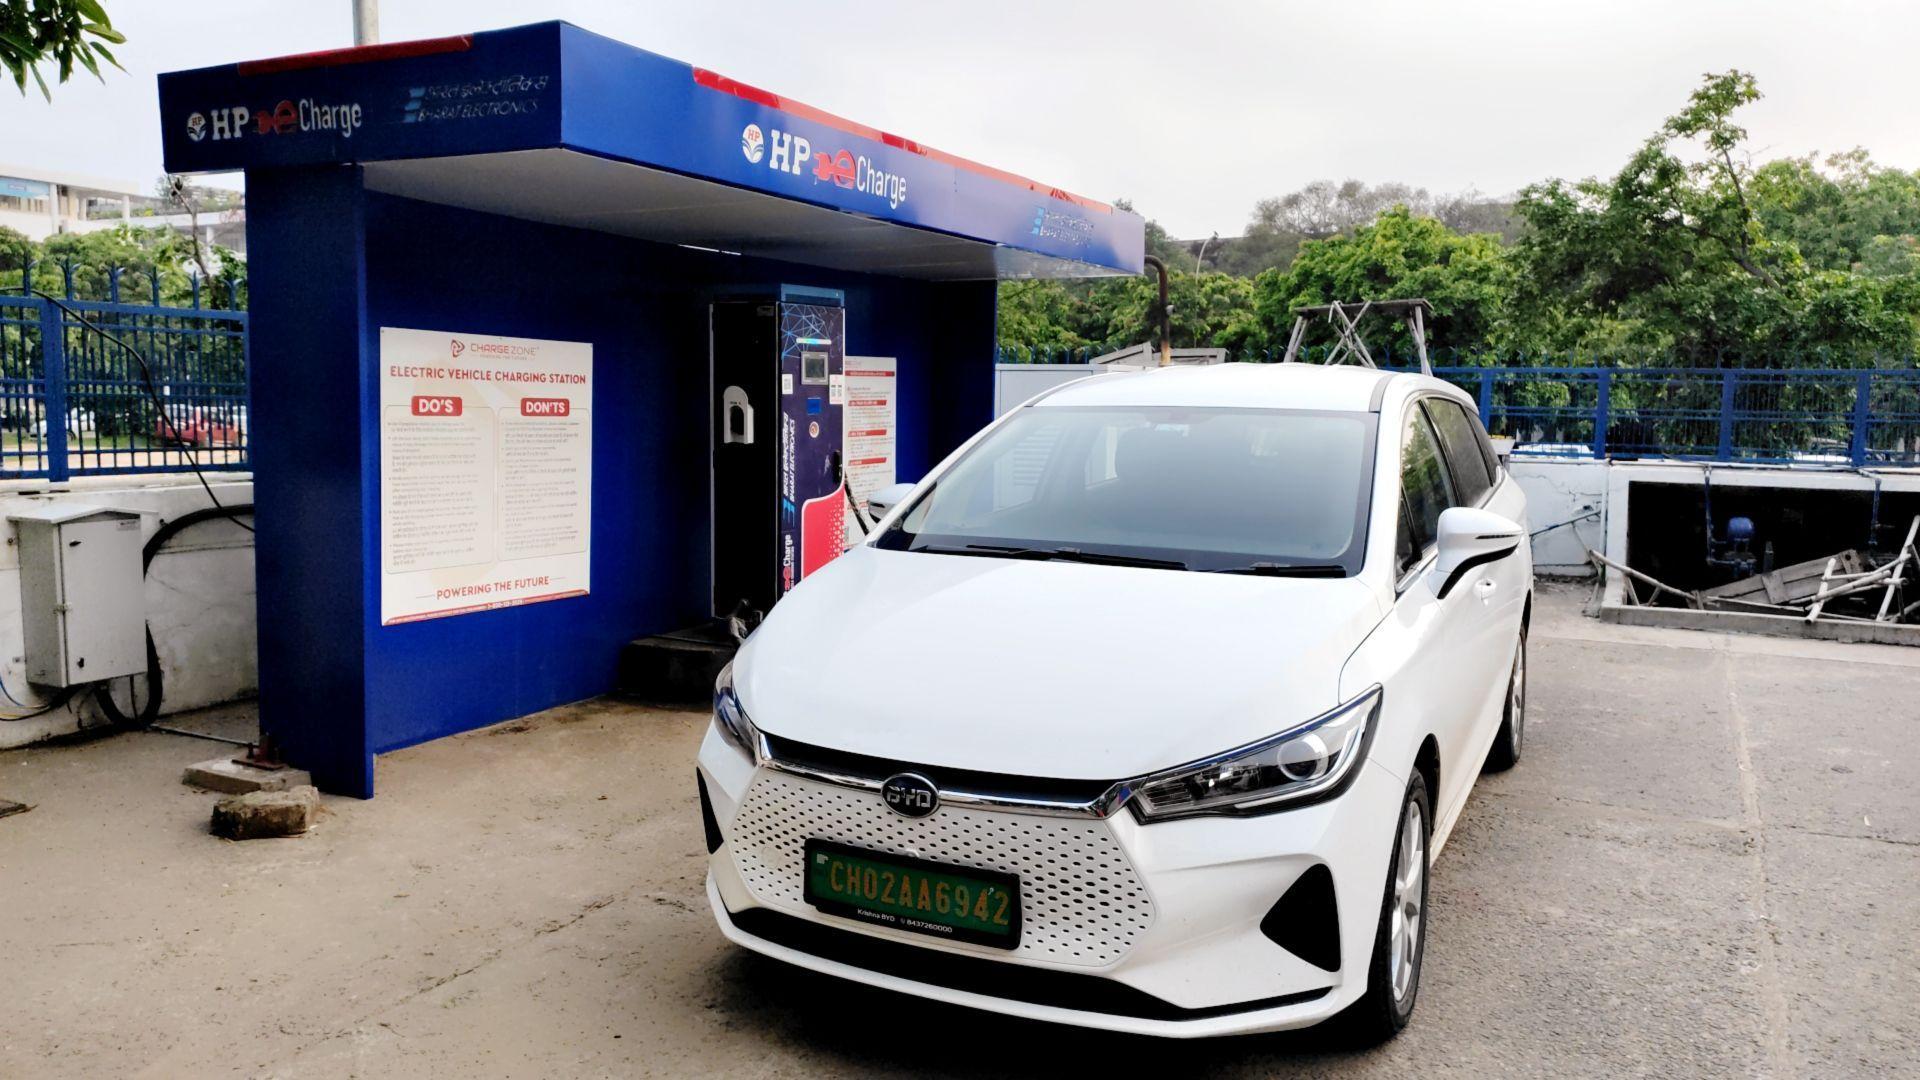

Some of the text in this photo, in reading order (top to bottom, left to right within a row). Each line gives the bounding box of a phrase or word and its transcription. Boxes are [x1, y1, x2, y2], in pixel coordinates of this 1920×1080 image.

[211, 106, 250, 140] HP
[769, 129, 811, 176] HP
[390, 365, 586, 385] ELECTRIC VEHICLE CHARGING STATION
[418, 398, 454, 413] DO'S
[525, 401, 565, 414] DON'TS
[437, 576, 550, 600] POWERING THE FUTURE
[886, 786, 931, 808] BYD
[830, 860, 1009, 926] CH02AA6942
[857, 907, 953, 933] Krishna BYD 8437260000
